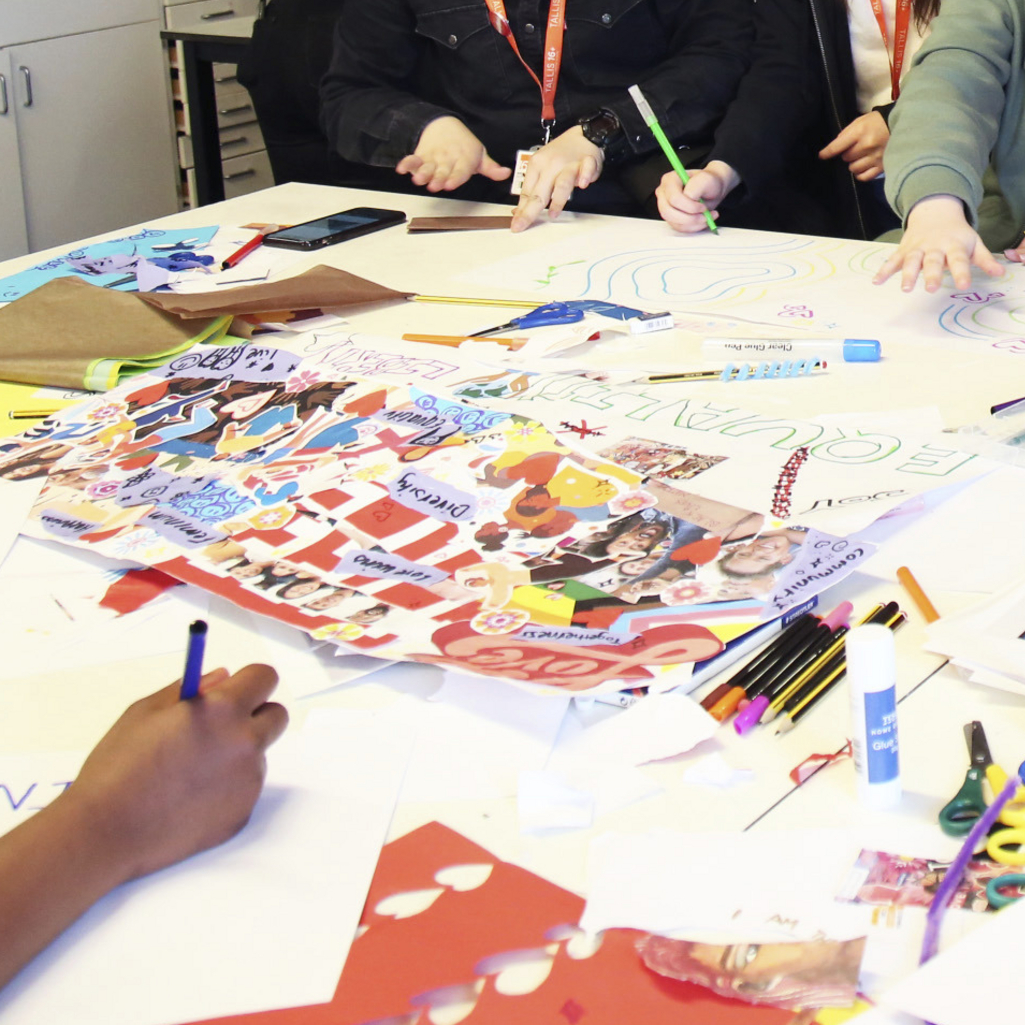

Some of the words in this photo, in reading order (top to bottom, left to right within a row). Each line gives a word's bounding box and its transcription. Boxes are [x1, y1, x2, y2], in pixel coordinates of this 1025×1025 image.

[547, 46, 556, 61] 16+
[545, 61, 555, 92] TALLIS
[744, 343, 766, 352] Glue
[767, 343, 793, 352] Clear
[395, 473, 470, 521] Diversity
[872, 739, 894, 751] Glue
